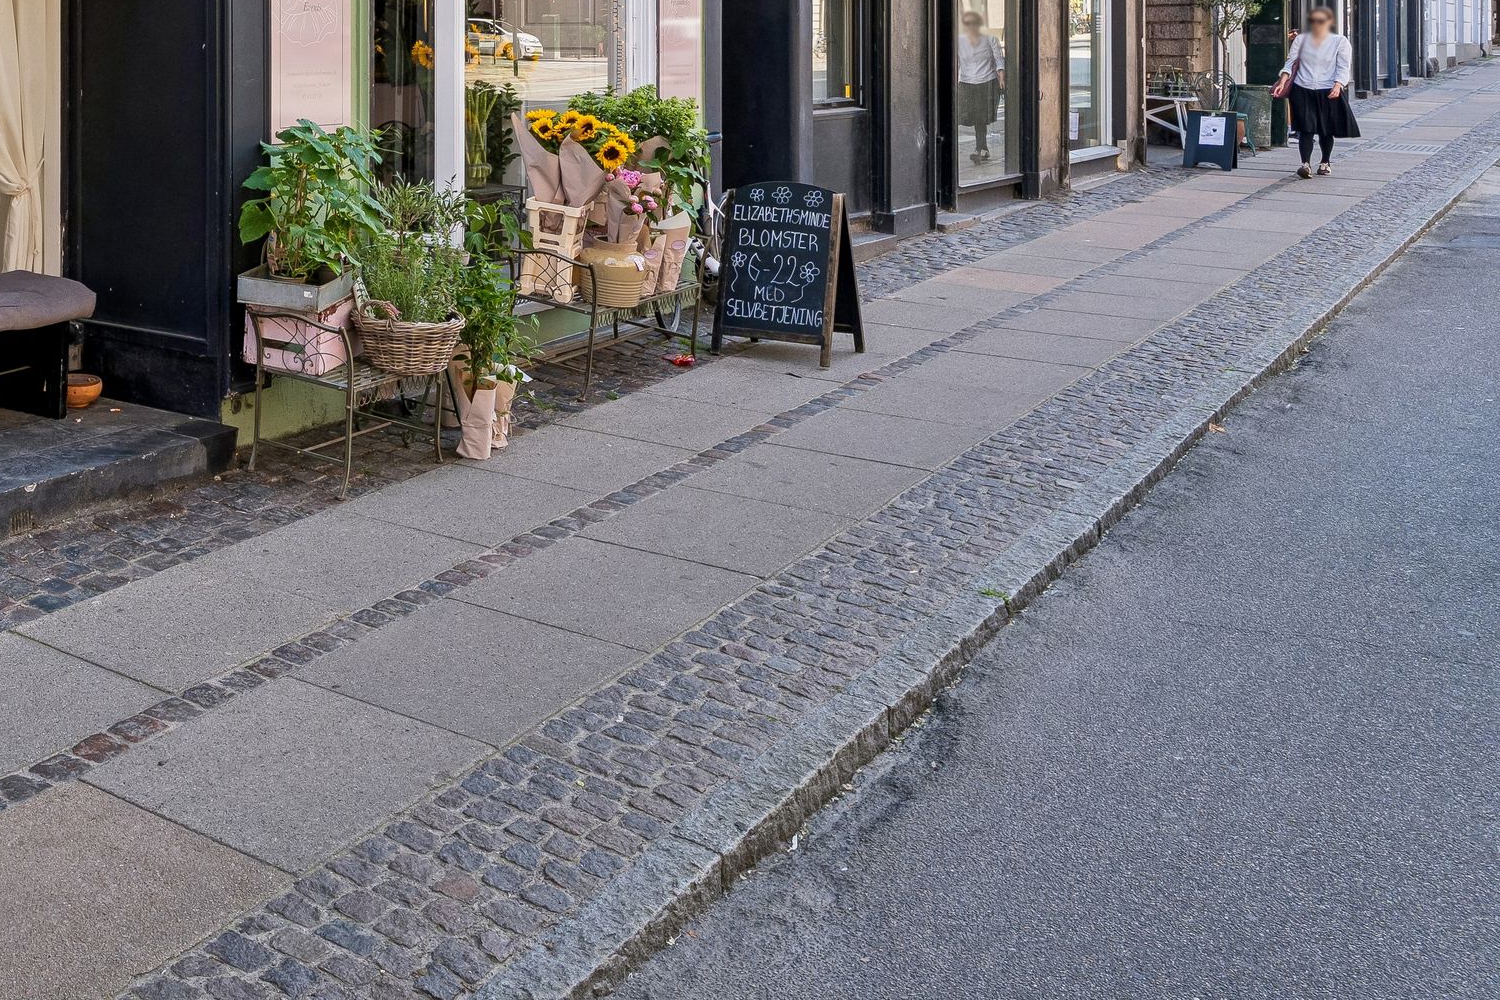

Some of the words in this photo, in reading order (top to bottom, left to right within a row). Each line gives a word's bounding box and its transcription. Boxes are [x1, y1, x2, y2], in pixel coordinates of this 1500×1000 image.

[733, 204, 831, 229] ELIZABETHSMINDE
[738, 228, 818, 252] BLOMSTER
[754, 286, 785, 302] MED
[726, 298, 823, 328] SELVBETJENING
